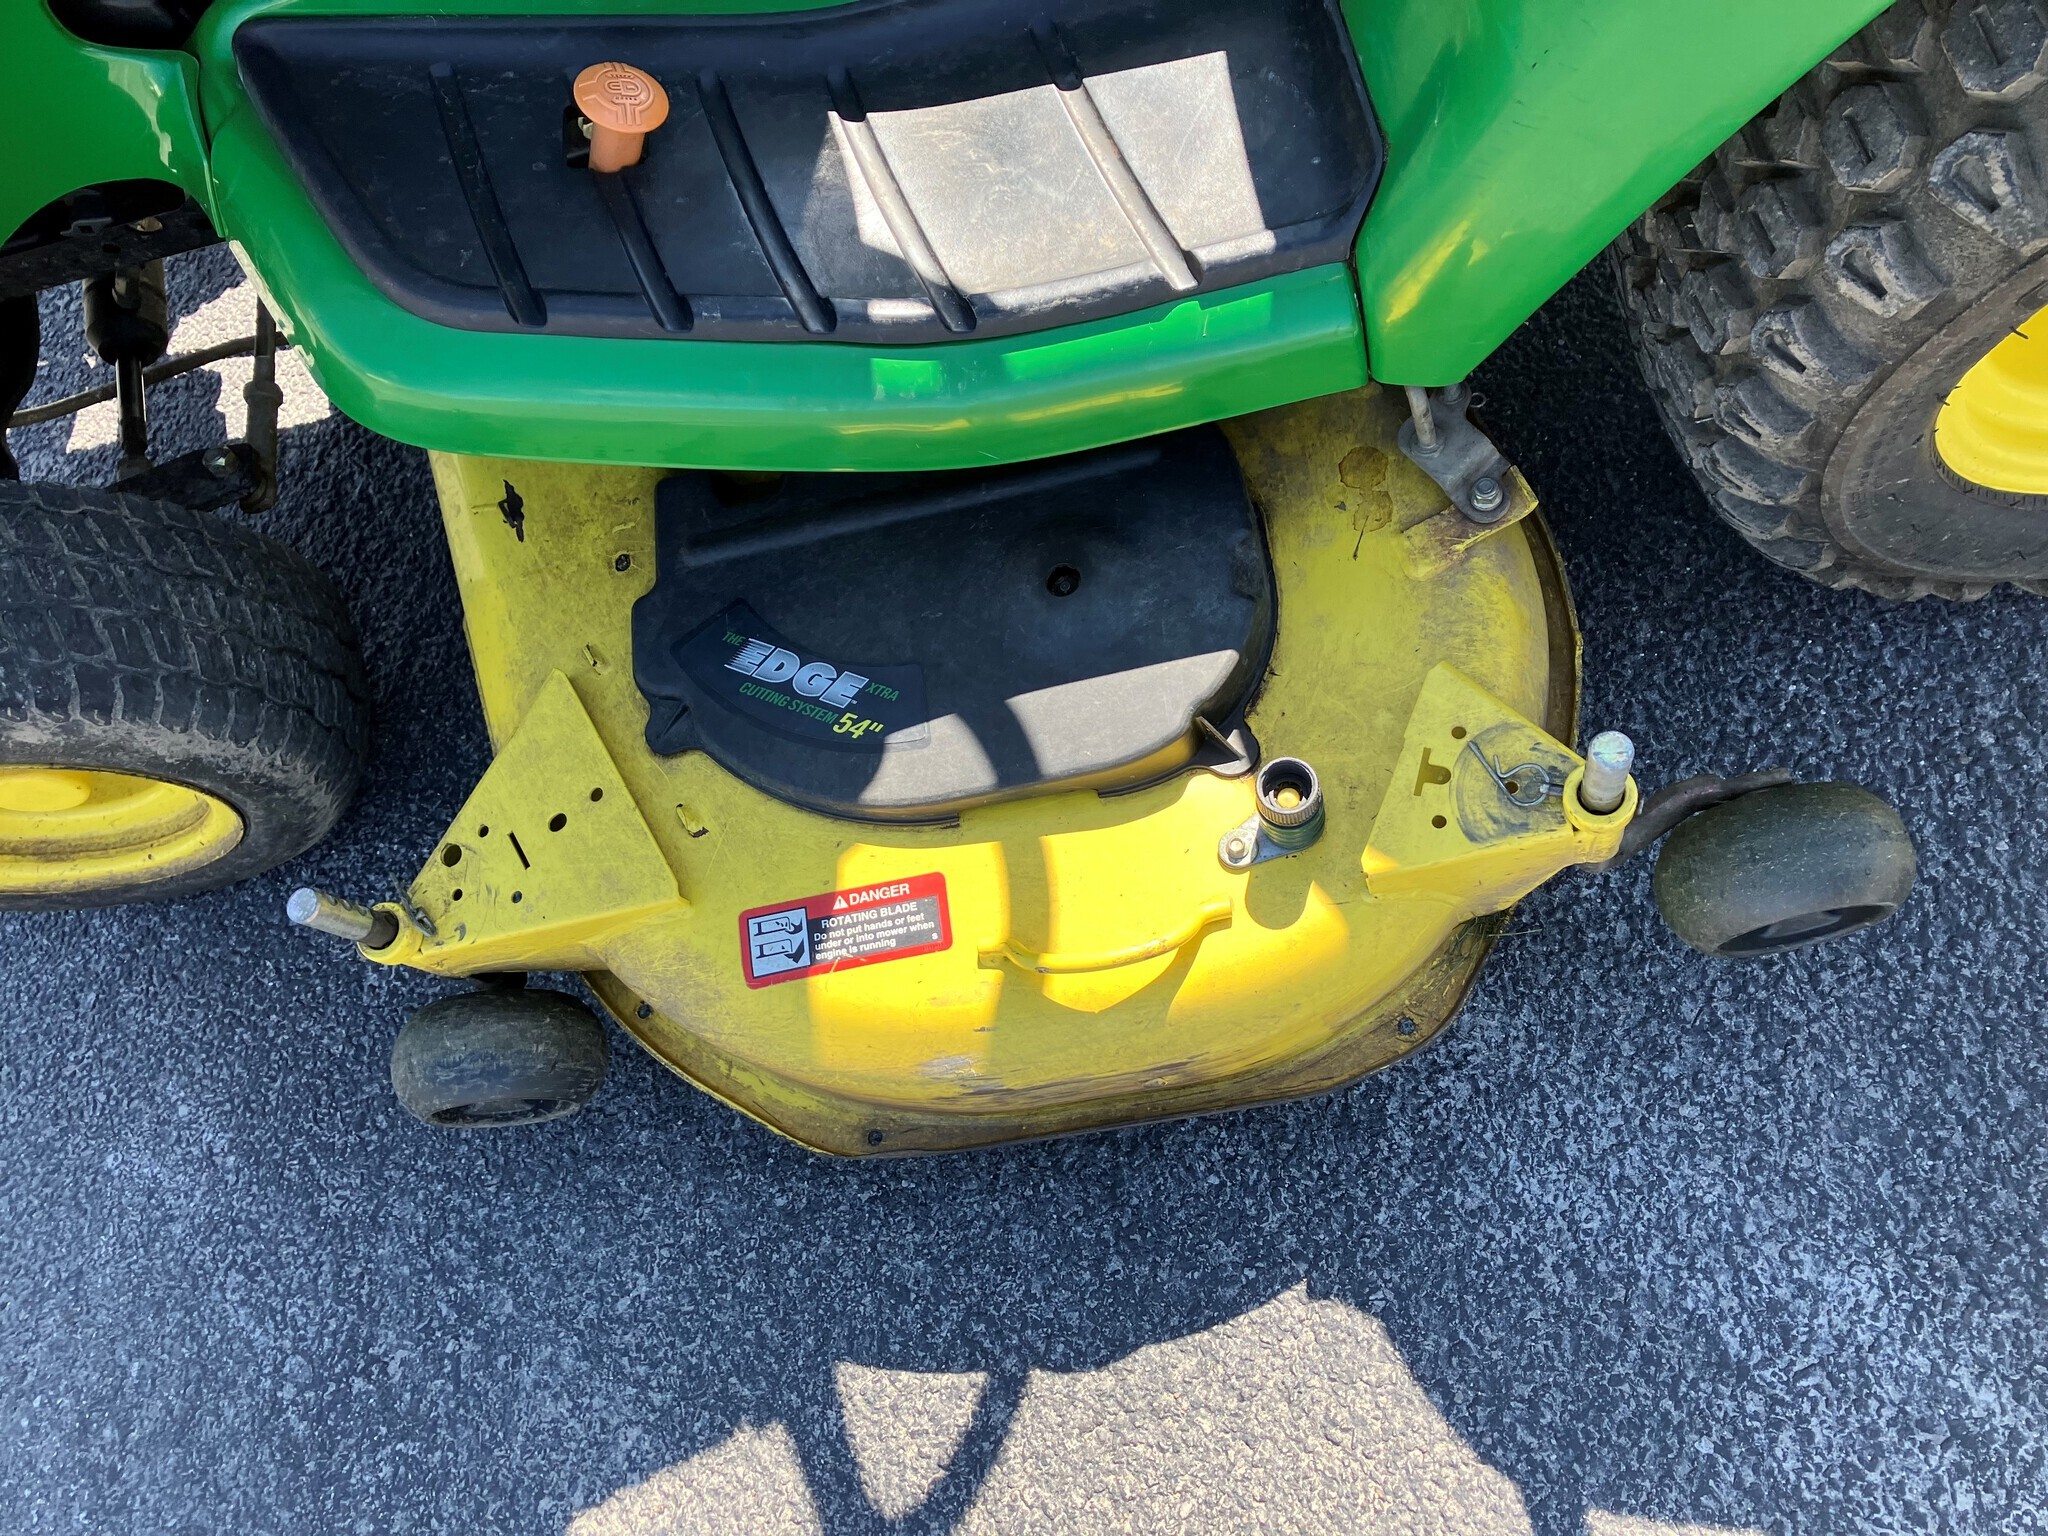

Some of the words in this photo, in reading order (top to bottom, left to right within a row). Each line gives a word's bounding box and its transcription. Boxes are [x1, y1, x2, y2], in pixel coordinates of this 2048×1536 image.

[722, 631, 746, 646] THE
[724, 638, 870, 708] EDGE
[739, 682, 788, 707] CUTTING
[787, 699, 839, 725] SYSTEM
[866, 682, 900, 702] XTRA
[832, 712, 884, 739] 54"
[849, 883, 910, 905] DANGER
[814, 932, 827, 941] Do
[829, 928, 845, 938] not
[846, 924, 862, 937] put
[863, 917, 893, 931] hands
[895, 917, 905, 925] or
[906, 912, 924, 923] feet
[821, 909, 878, 929] ROTATING
[879, 901, 918, 917] BLADE
[815, 939, 841, 950] under
[844, 937, 854, 945] or
[856, 932, 874, 943] into
[876, 926, 907, 938] mower
[909, 921, 935, 932] when
[815, 947, 847, 960] engine
[849, 945, 858, 953] is
[859, 938, 896, 951] running
